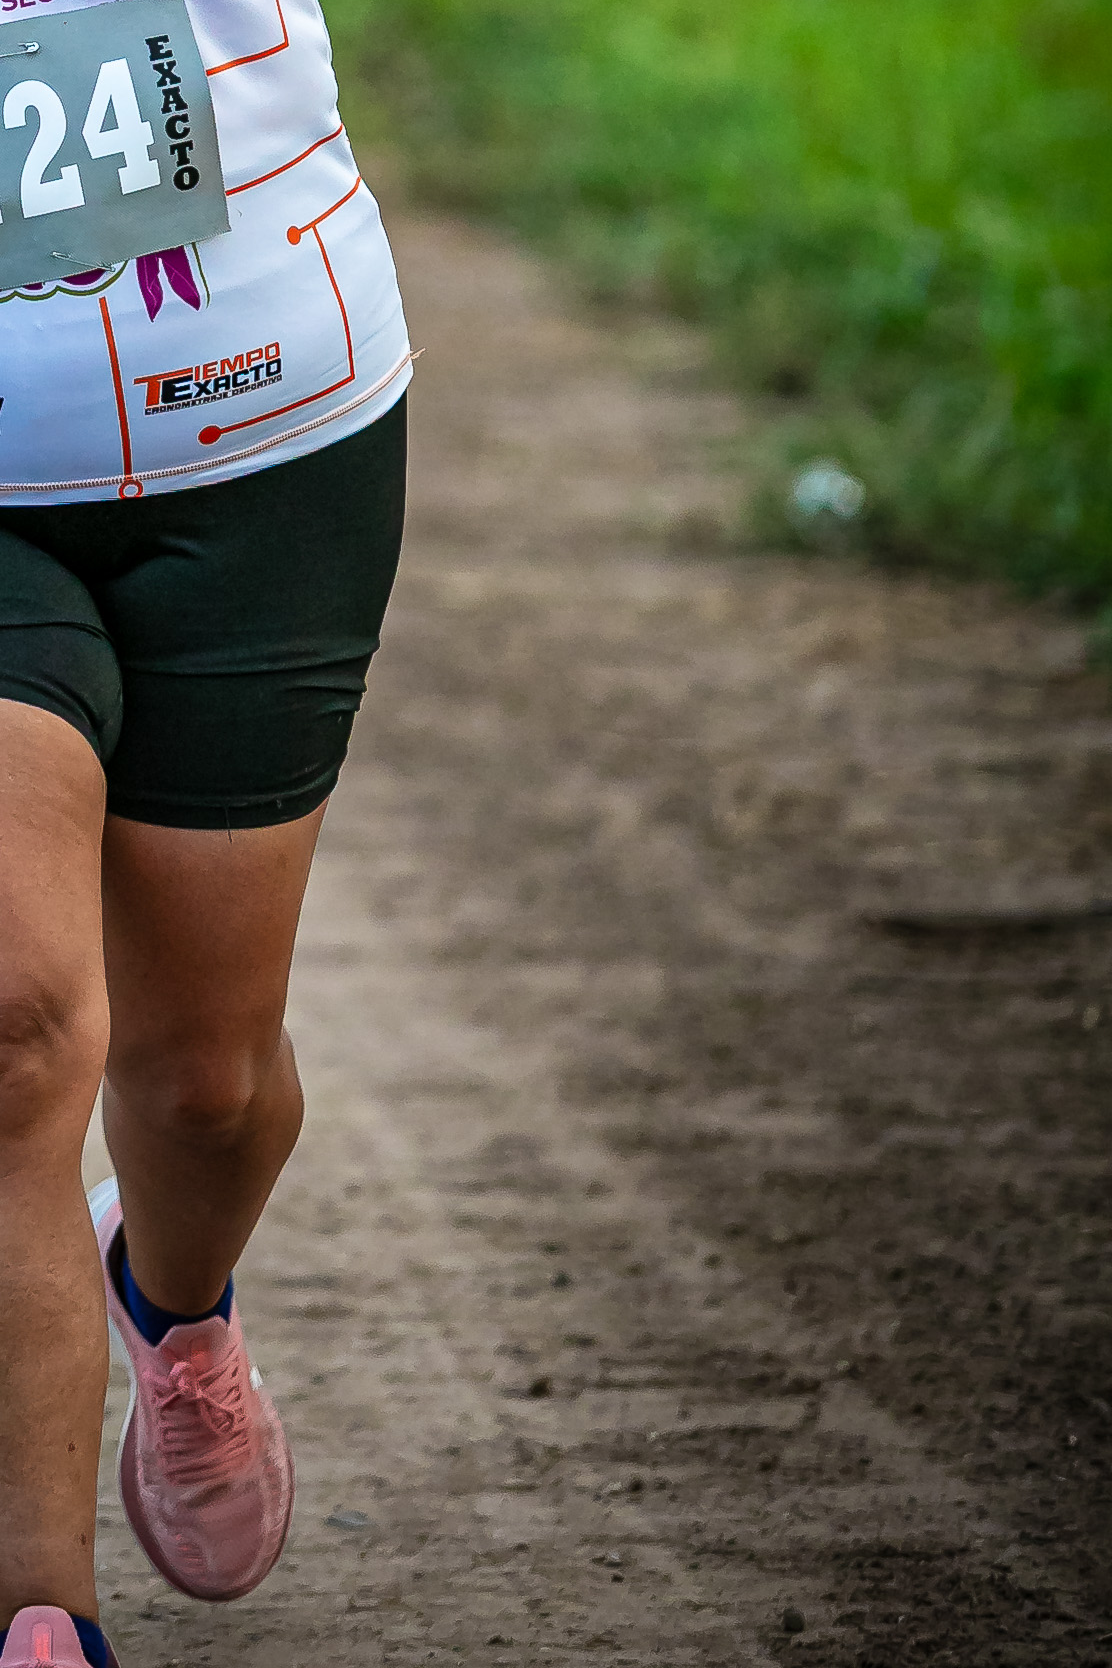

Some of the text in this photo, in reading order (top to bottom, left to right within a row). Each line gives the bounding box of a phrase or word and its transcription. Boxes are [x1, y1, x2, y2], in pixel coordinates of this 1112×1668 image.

[144, 34, 201, 192] EXACTO
[133, 341, 282, 407] TIEMPO
[160, 357, 282, 404] EXACTO
